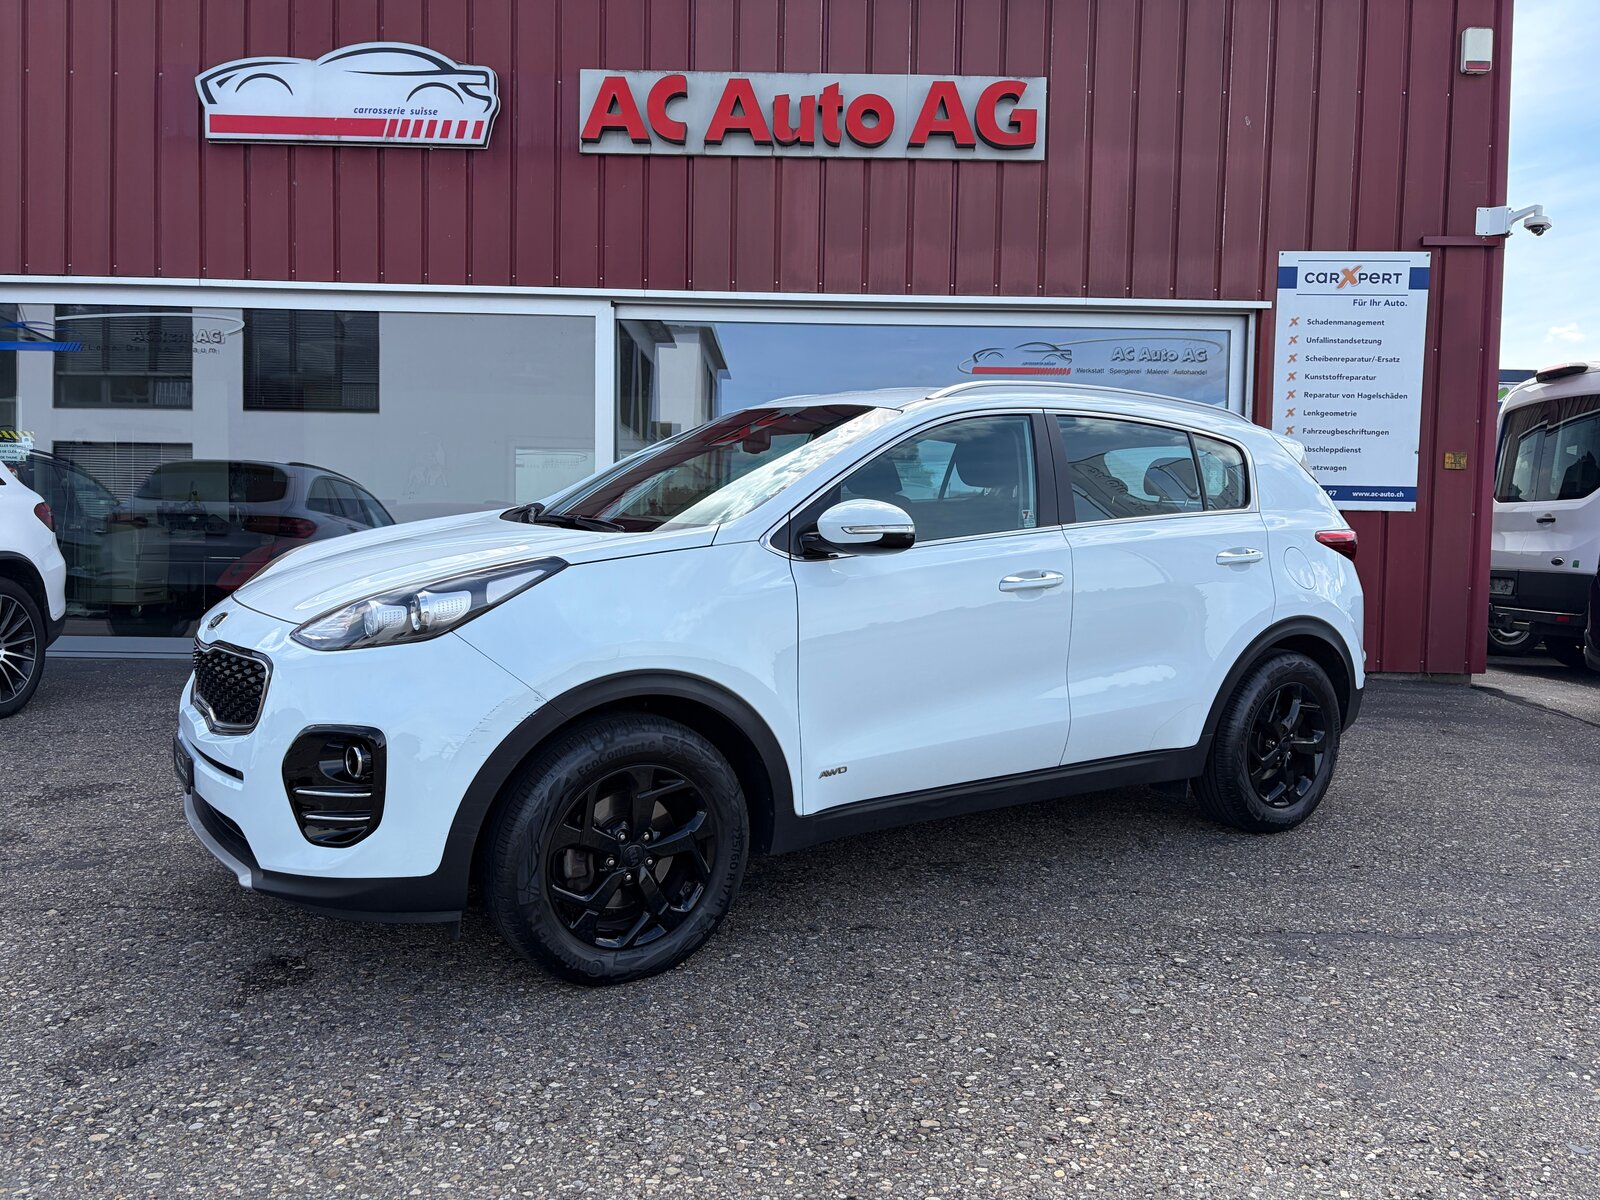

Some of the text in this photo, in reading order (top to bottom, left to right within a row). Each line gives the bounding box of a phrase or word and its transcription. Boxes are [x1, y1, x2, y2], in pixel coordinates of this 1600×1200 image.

[353, 105, 438, 116] carrosserie suisse
[581, 74, 1038, 150] AC Auto AG
[1353, 299, 1408, 307] Für Ihr Auto.
[1307, 318, 1385, 328] Schadenmanagement
[196, 329, 225, 344] AG
[1306, 337, 1382, 346] Unfallinstandsetzung
[1111, 346, 1208, 363] AC Auto AG
[1305, 355, 1400, 364] Scheibenreparatur/-Ersatz
[1304, 373, 1377, 382] Kunststoffreparatur
[1303, 391, 1339, 400] Reparatur
[1357, 391, 1408, 400] Hagelschäden
[1303, 410, 1357, 418] Lenkgeometrie
[1302, 428, 1389, 436] Fahrzeugbeschriftungen
[1310, 464, 1347, 472] atzwagen
[1352, 490, 1404, 498] www.ac-auto.ch
[818, 766, 848, 779] AWD
